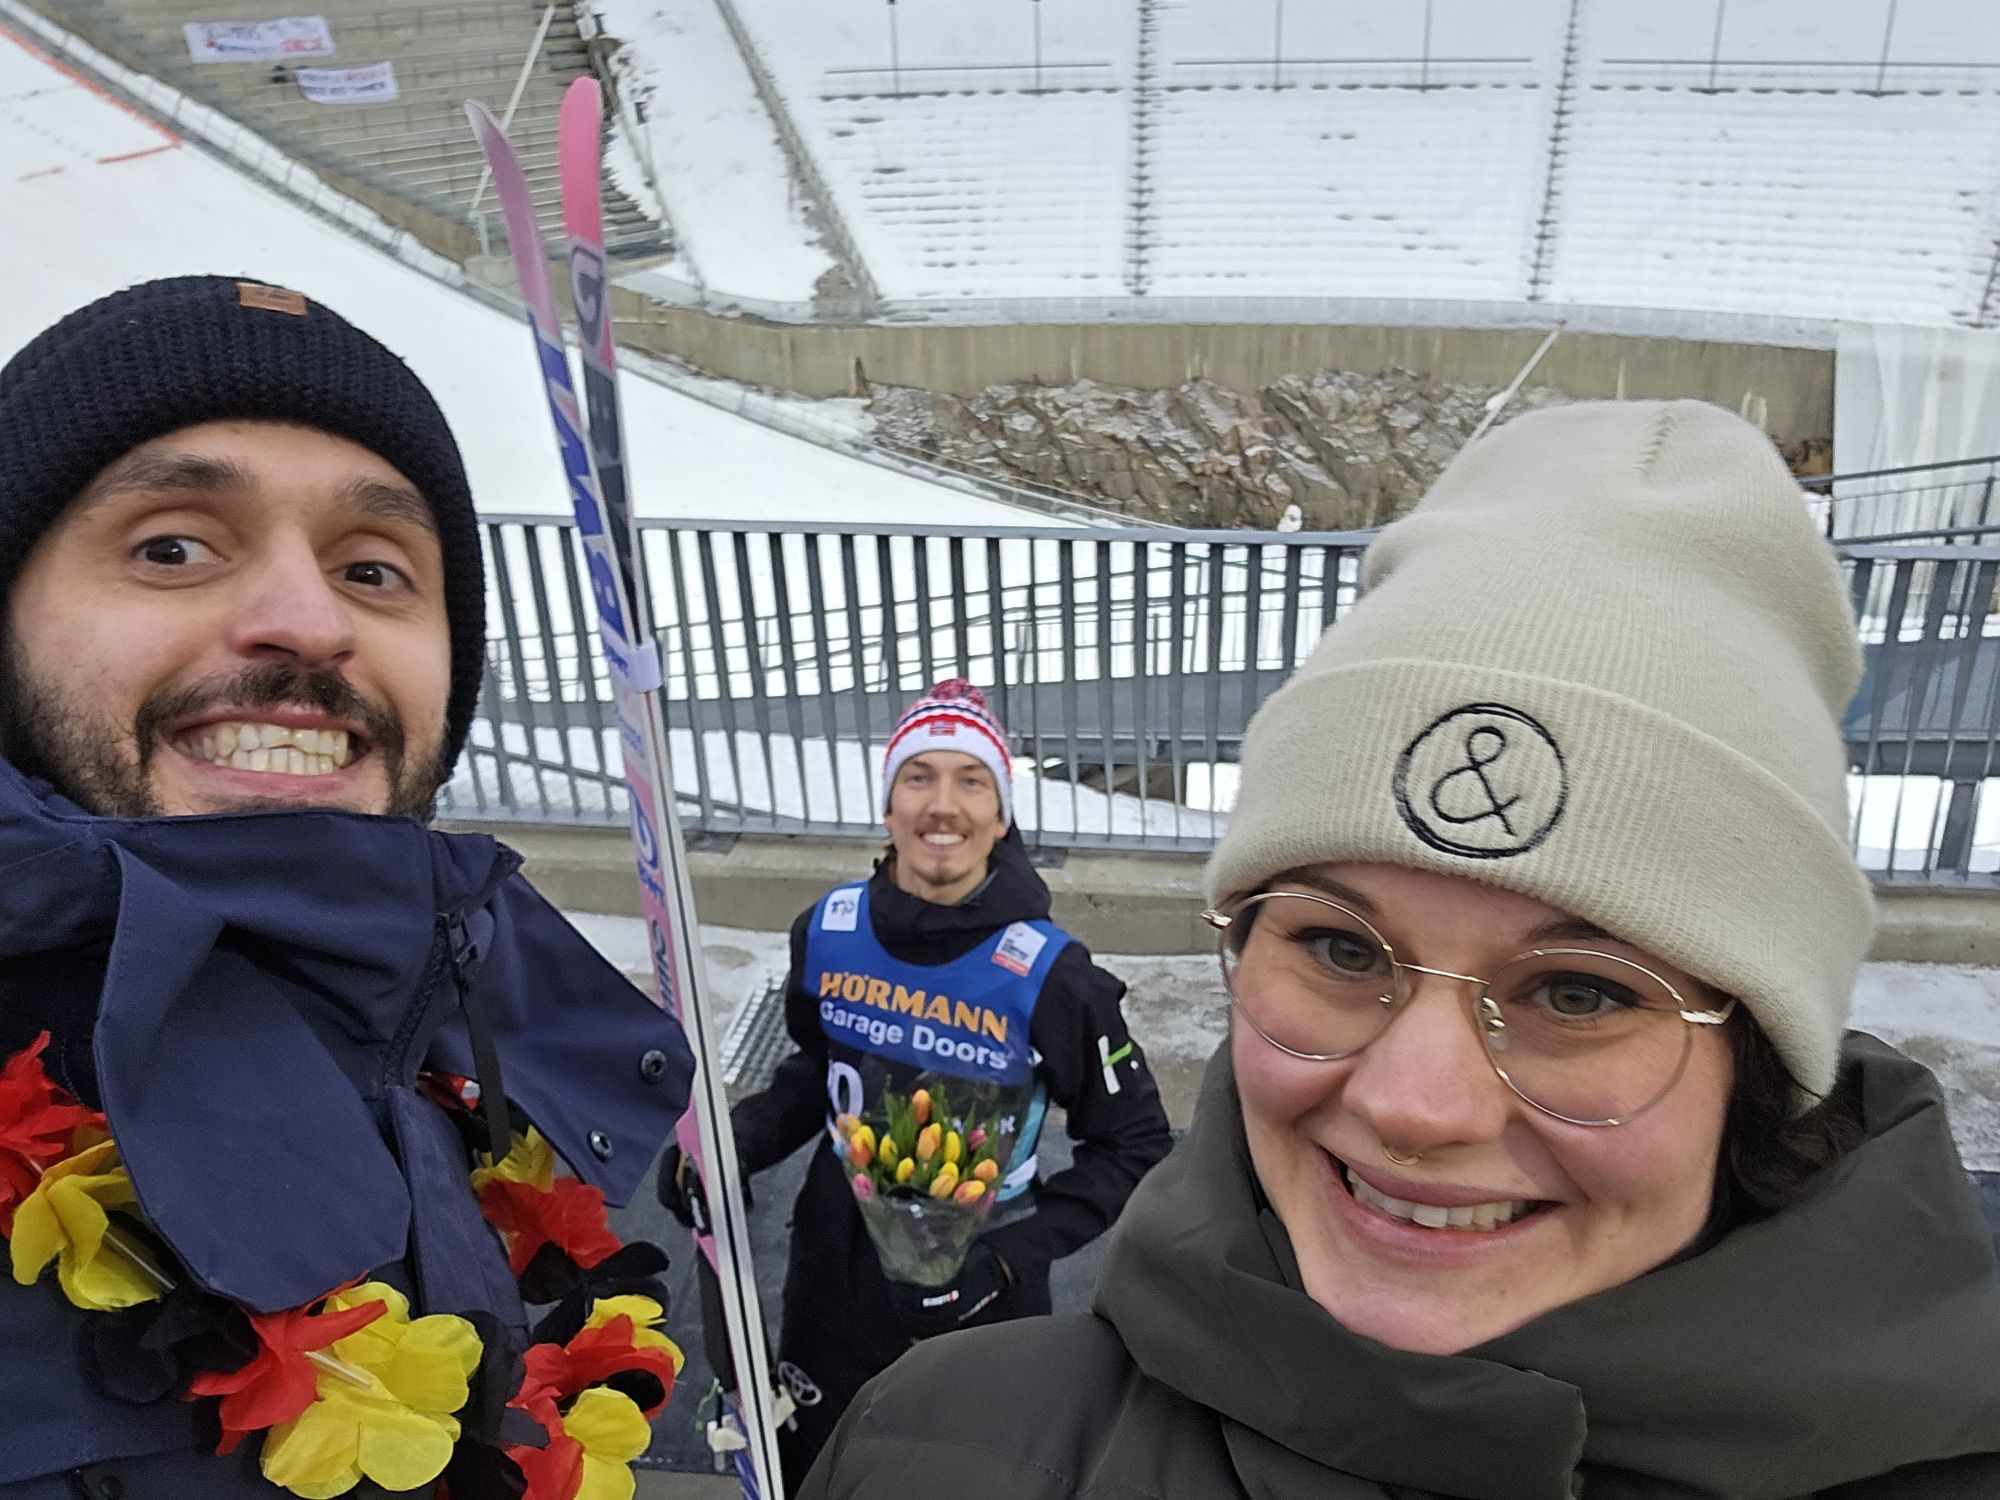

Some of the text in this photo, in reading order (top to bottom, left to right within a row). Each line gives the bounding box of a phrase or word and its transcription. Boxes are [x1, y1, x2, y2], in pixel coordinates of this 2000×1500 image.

[818, 971, 1009, 1044] HÖRMANN
[818, 1000, 1010, 1070] Garage Doors
